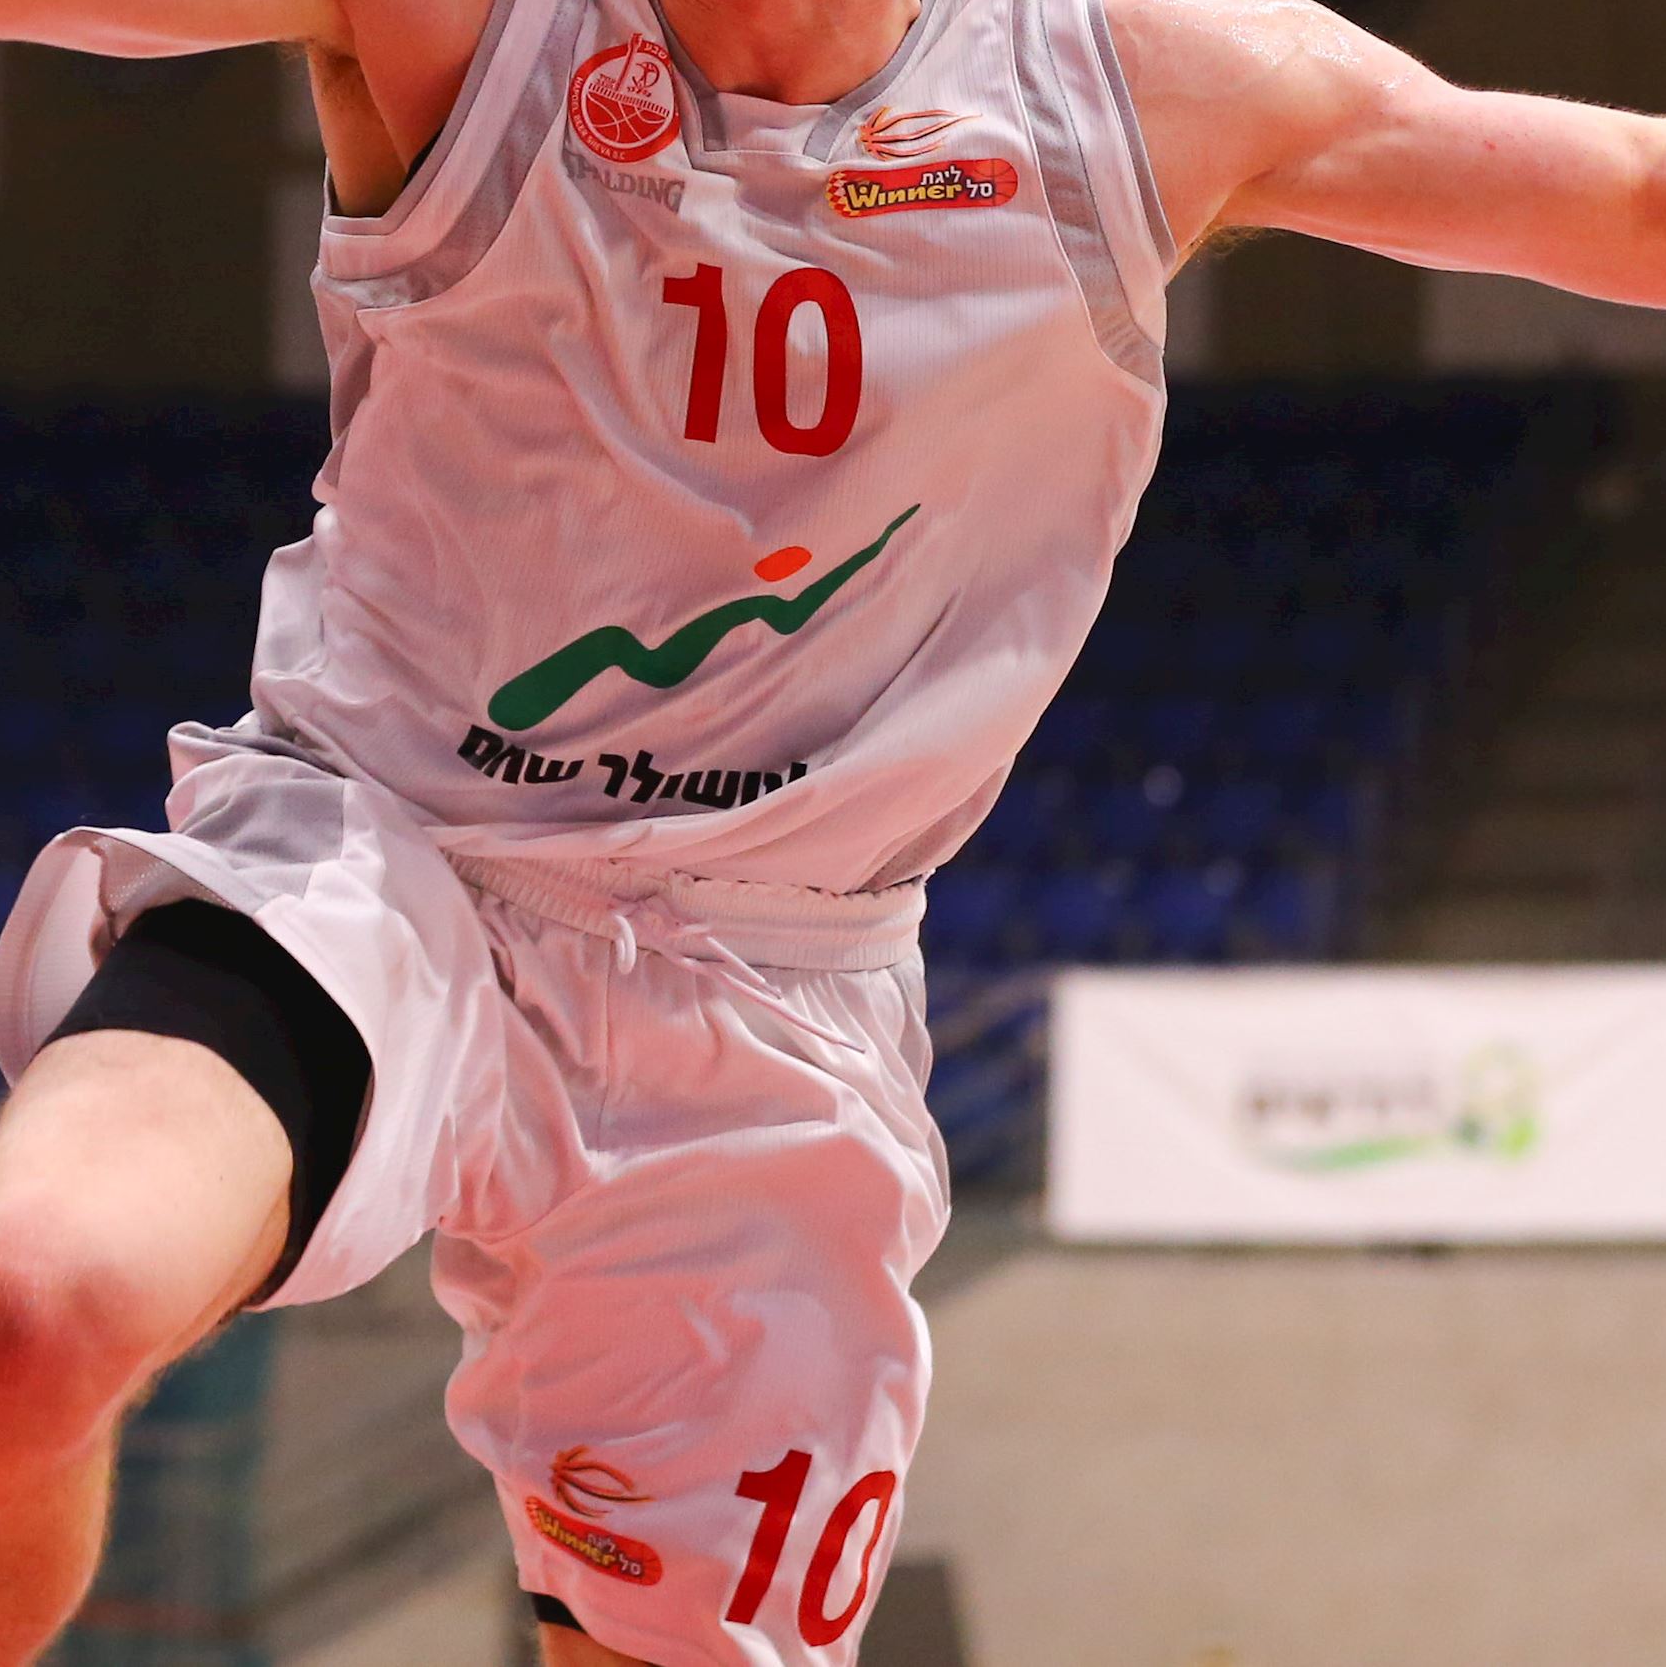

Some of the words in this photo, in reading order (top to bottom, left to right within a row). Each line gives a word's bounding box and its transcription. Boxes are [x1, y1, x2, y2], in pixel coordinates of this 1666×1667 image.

[562, 148, 686, 213] SPALDING
[846, 183, 963, 209] Winner
[965, 178, 994, 198] סל
[920, 165, 962, 186] ליגת
[662, 261, 863, 458] 10
[724, 1449, 897, 1647] 10
